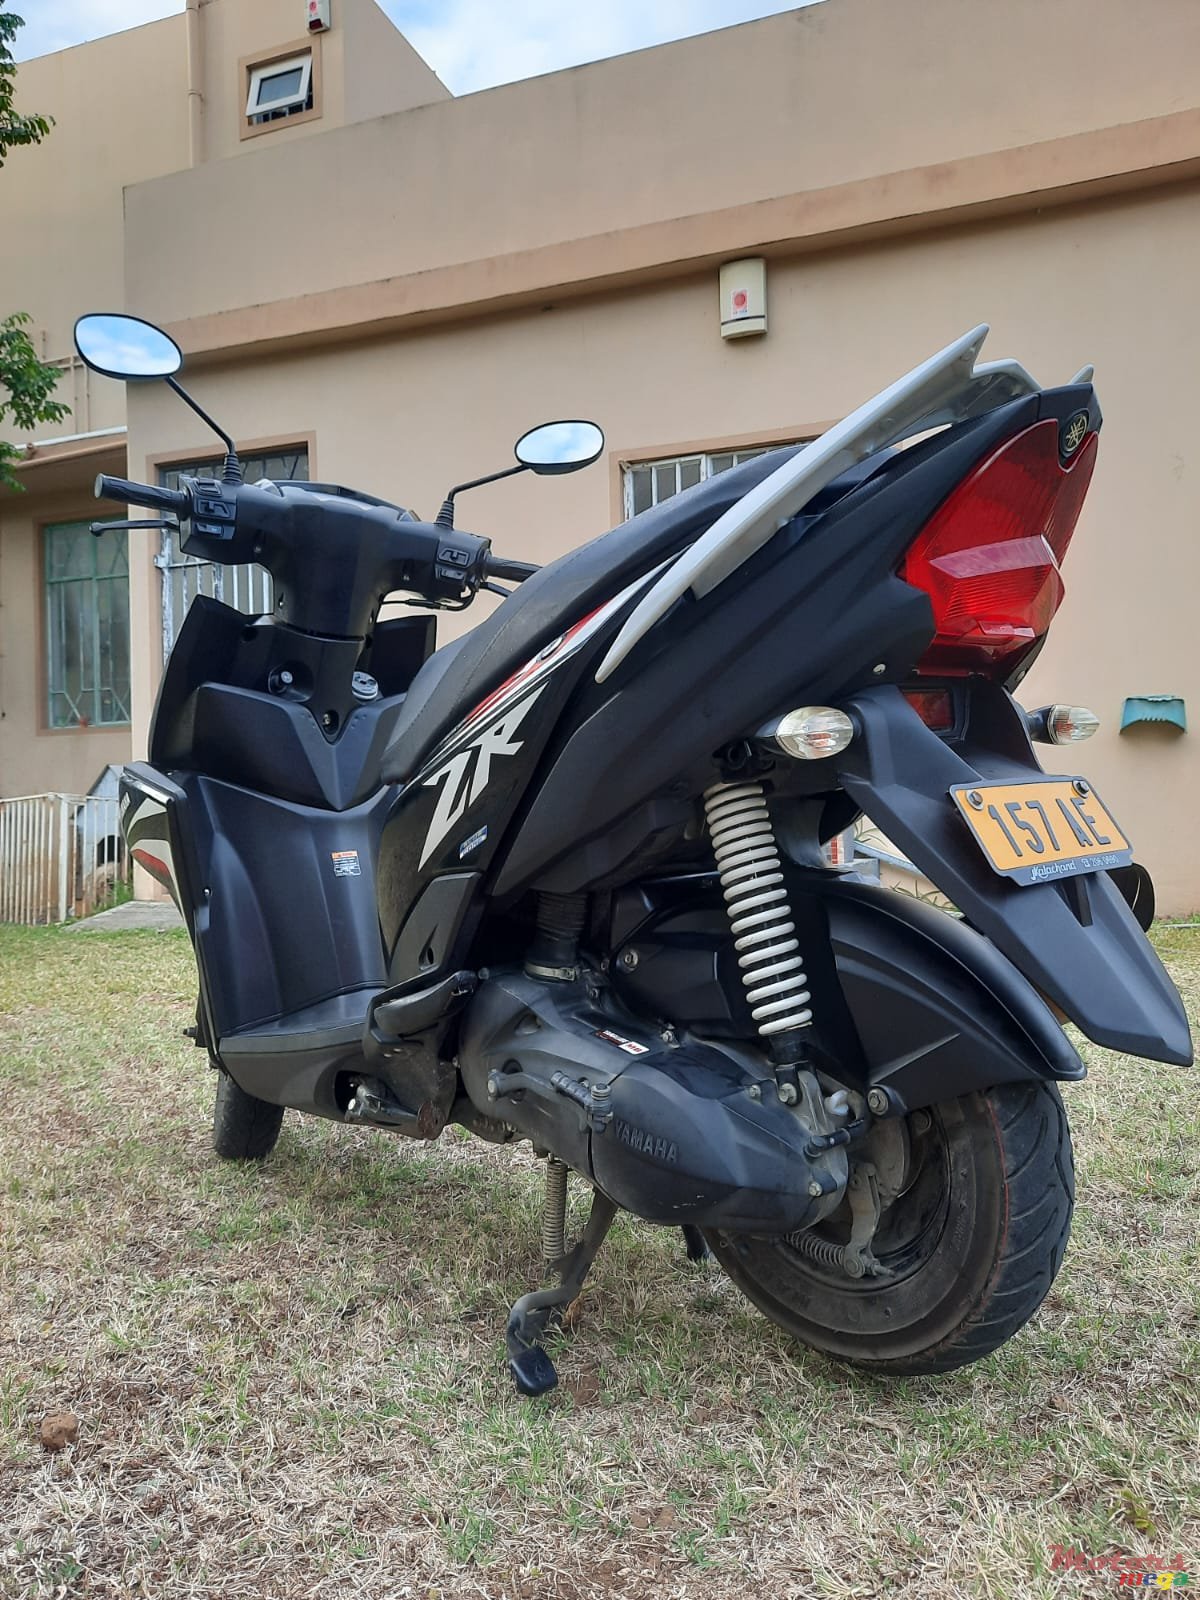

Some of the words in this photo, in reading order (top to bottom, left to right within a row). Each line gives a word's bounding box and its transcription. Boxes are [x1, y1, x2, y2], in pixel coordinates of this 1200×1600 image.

[988, 800, 1060, 857] 157
[1055, 797, 1111, 847] AE
[615, 1120, 678, 1163] YAMAHA
